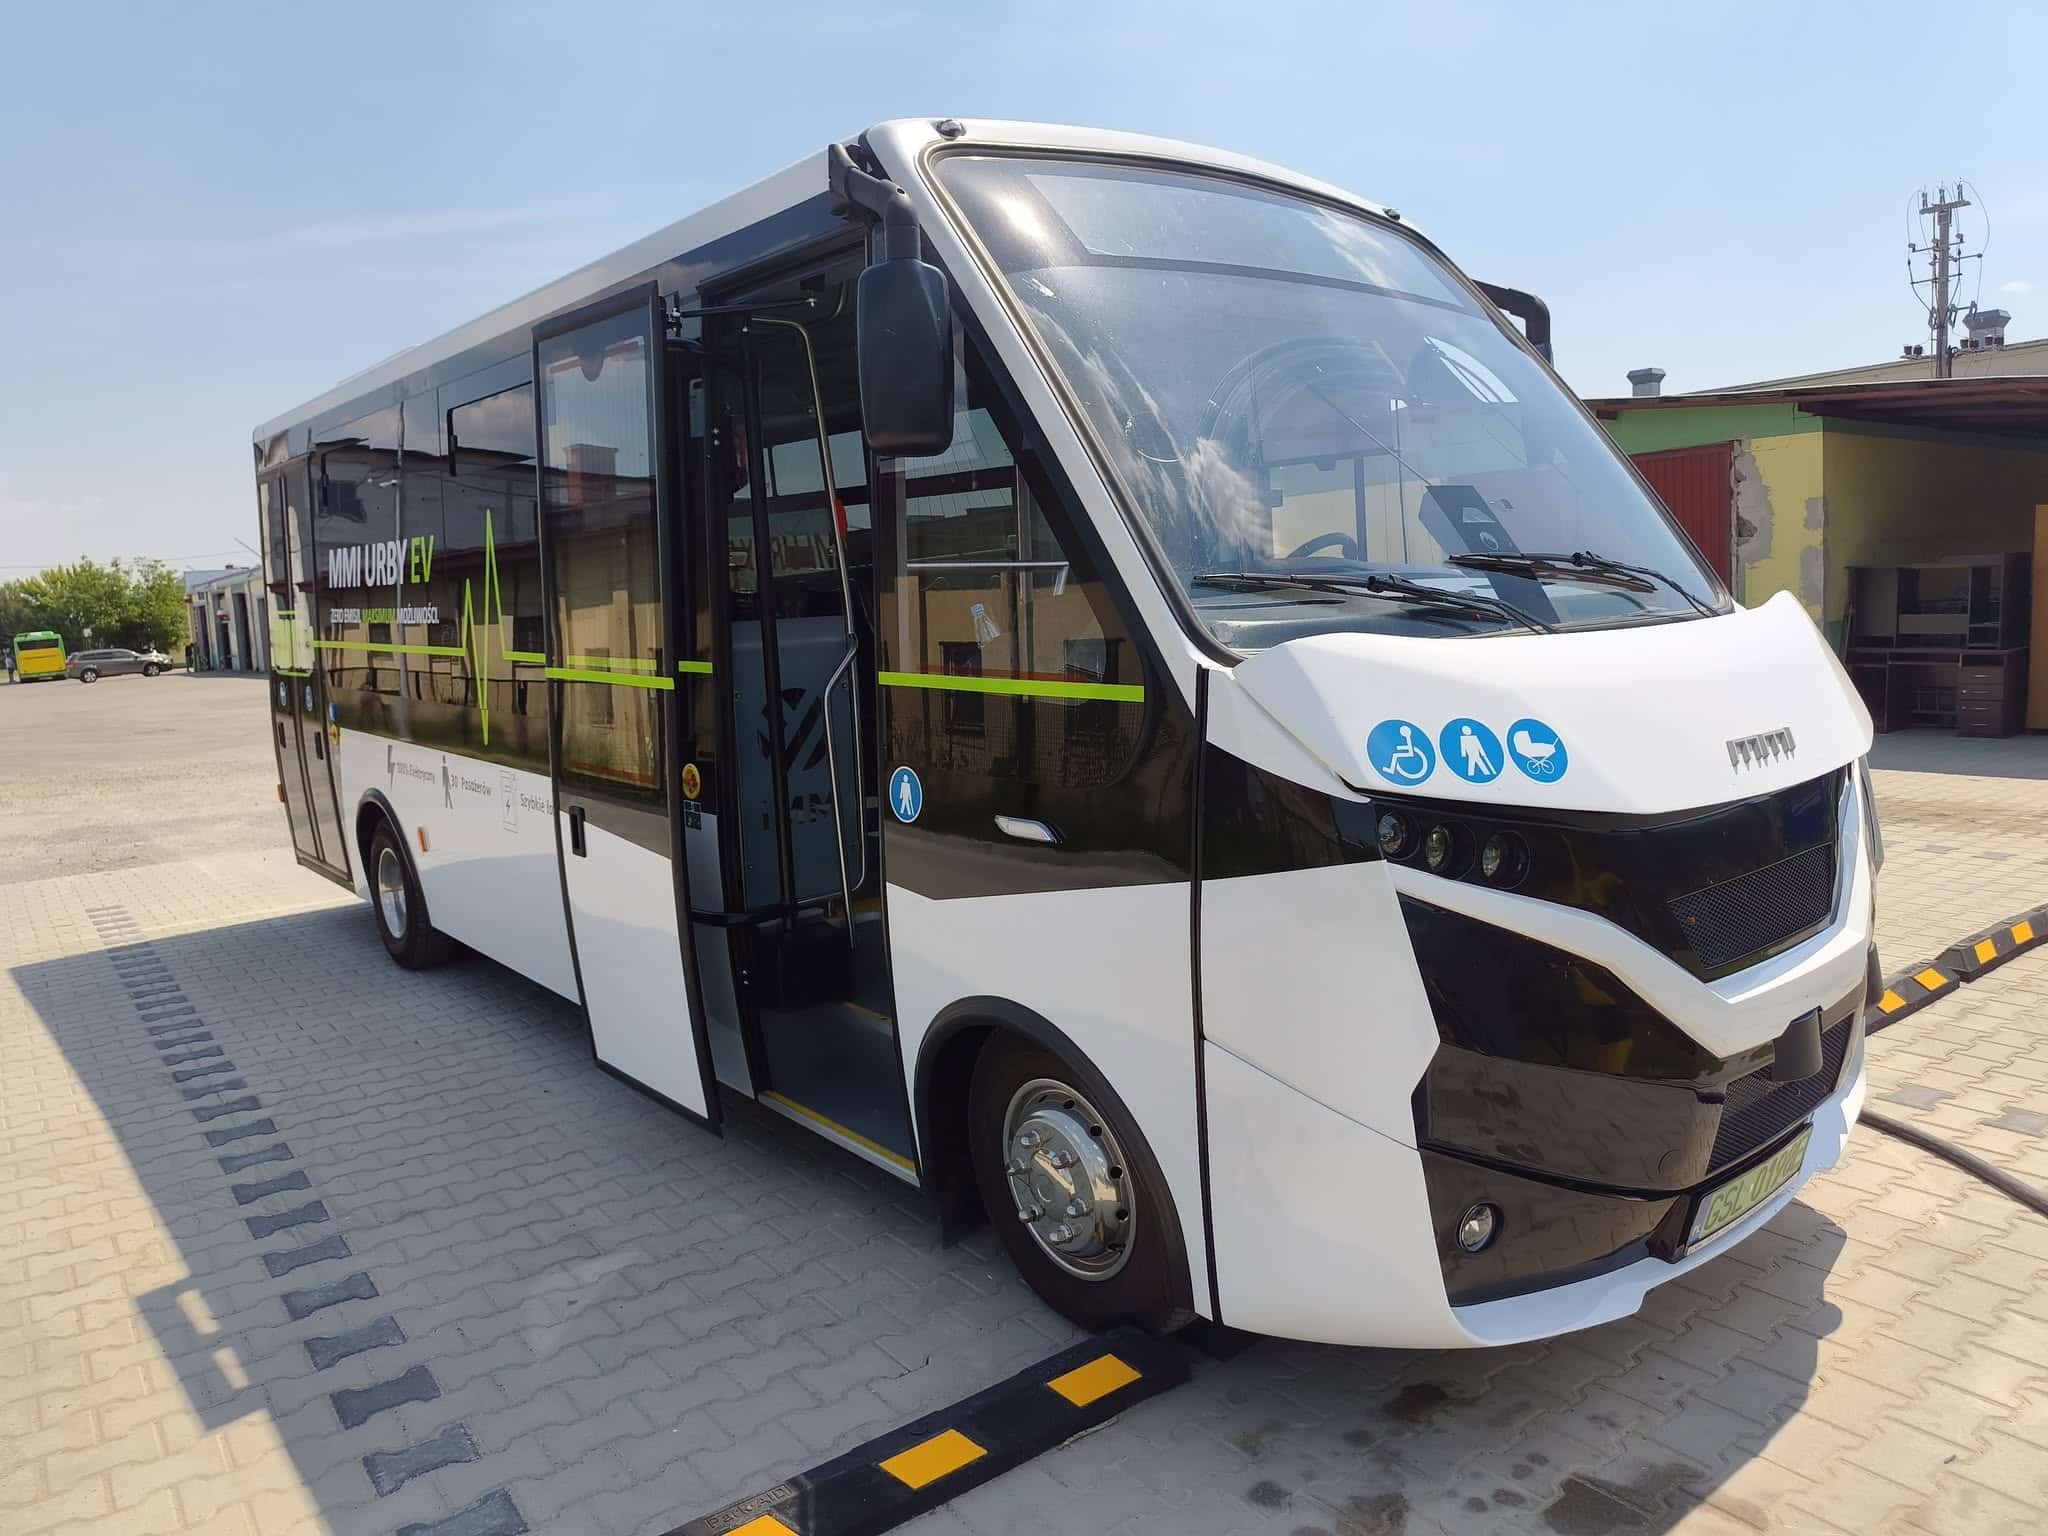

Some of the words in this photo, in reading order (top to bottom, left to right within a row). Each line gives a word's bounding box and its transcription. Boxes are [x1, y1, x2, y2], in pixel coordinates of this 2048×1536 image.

[329, 547, 361, 589] MMI
[365, 539, 407, 587] URBY
[411, 535, 434, 584] EV
